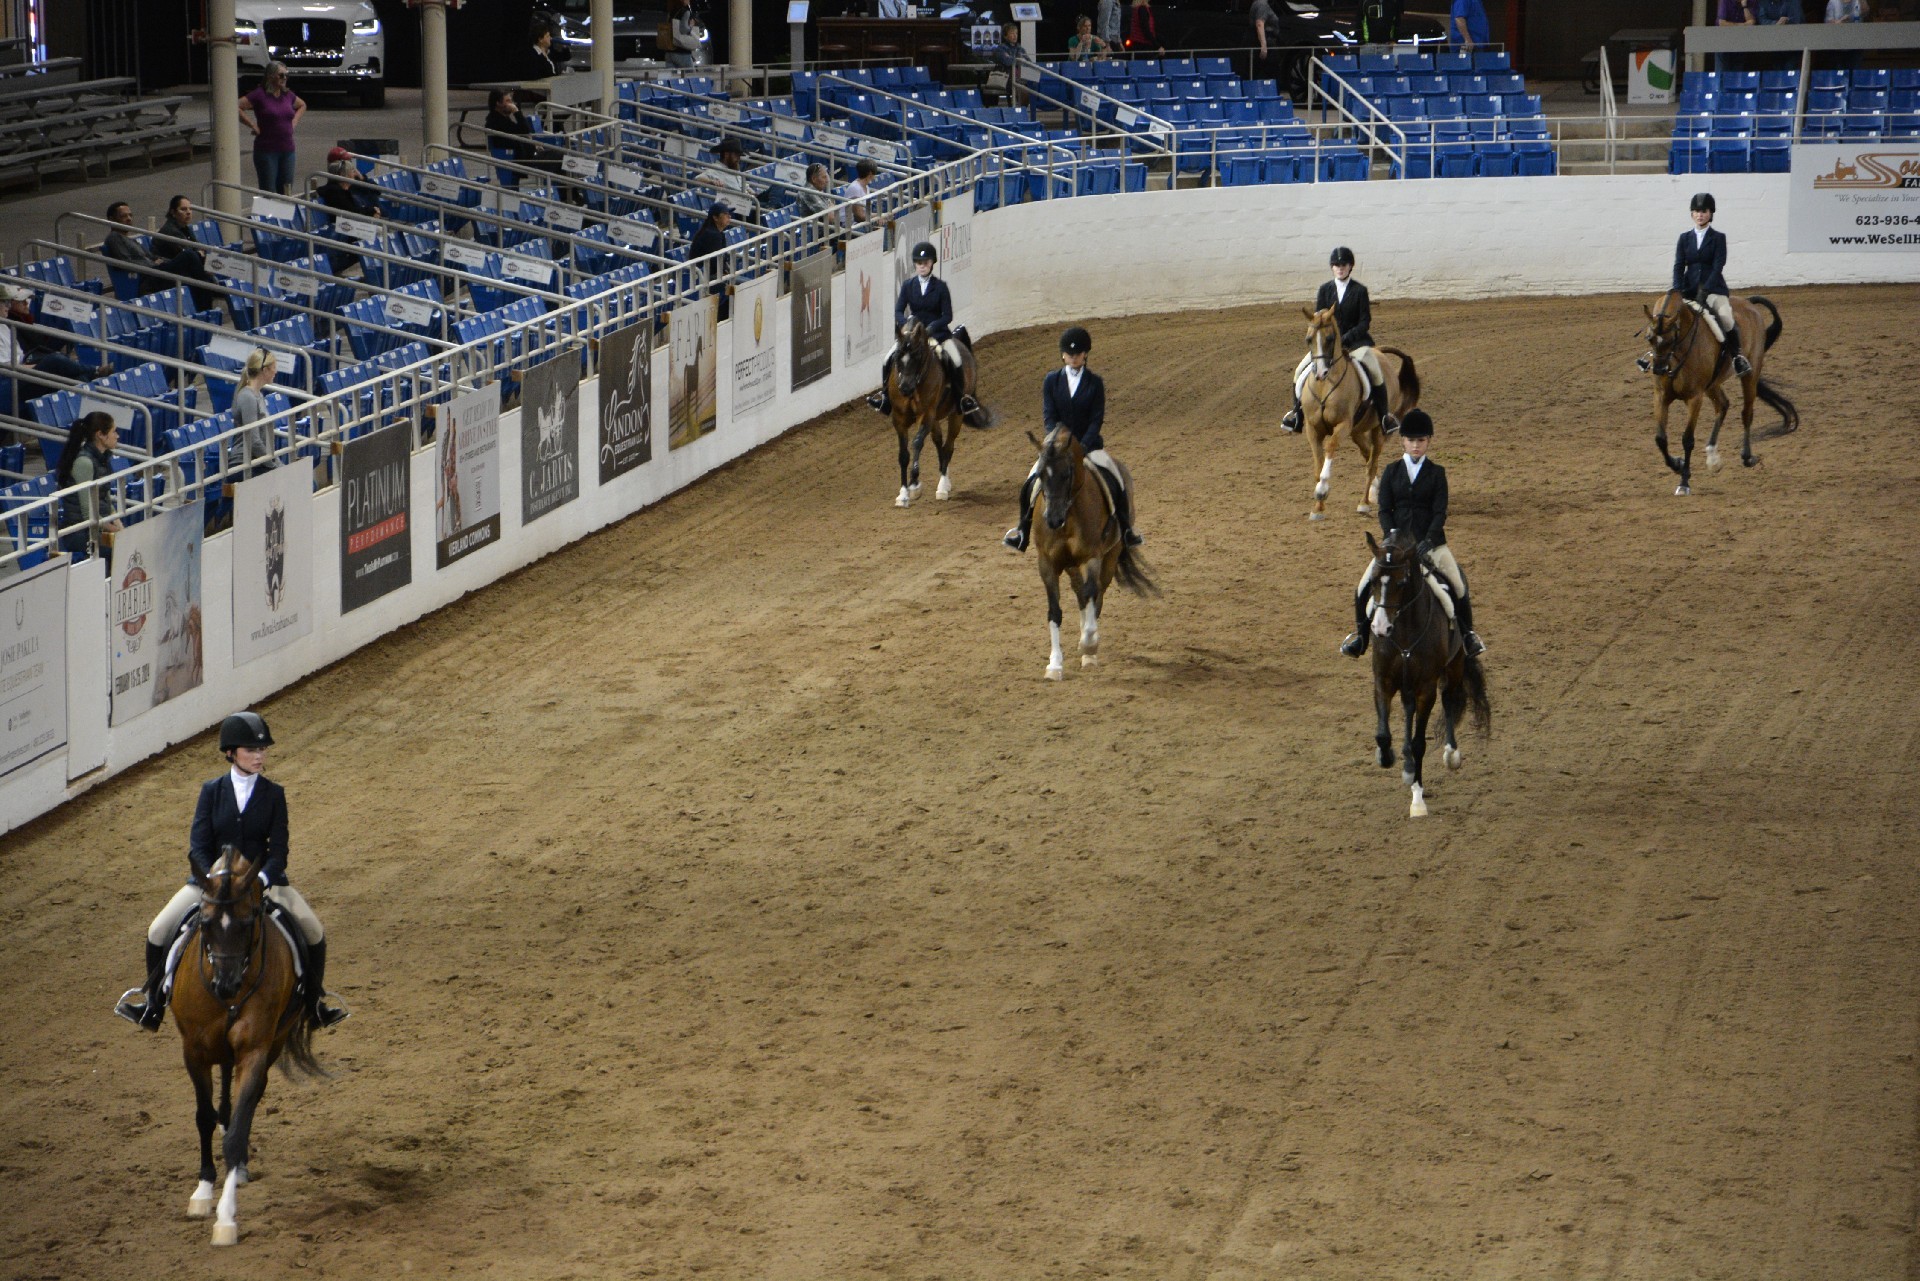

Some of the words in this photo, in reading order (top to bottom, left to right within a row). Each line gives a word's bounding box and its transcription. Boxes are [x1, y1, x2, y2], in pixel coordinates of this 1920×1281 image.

[1853, 193, 1889, 204] Specialize
[541, 452, 573, 494] JARVIS
[348, 459, 405, 532] PLATINUM
[350, 515, 404, 550] PERFORMANCE
[116, 581, 153, 622] ARABIAN
